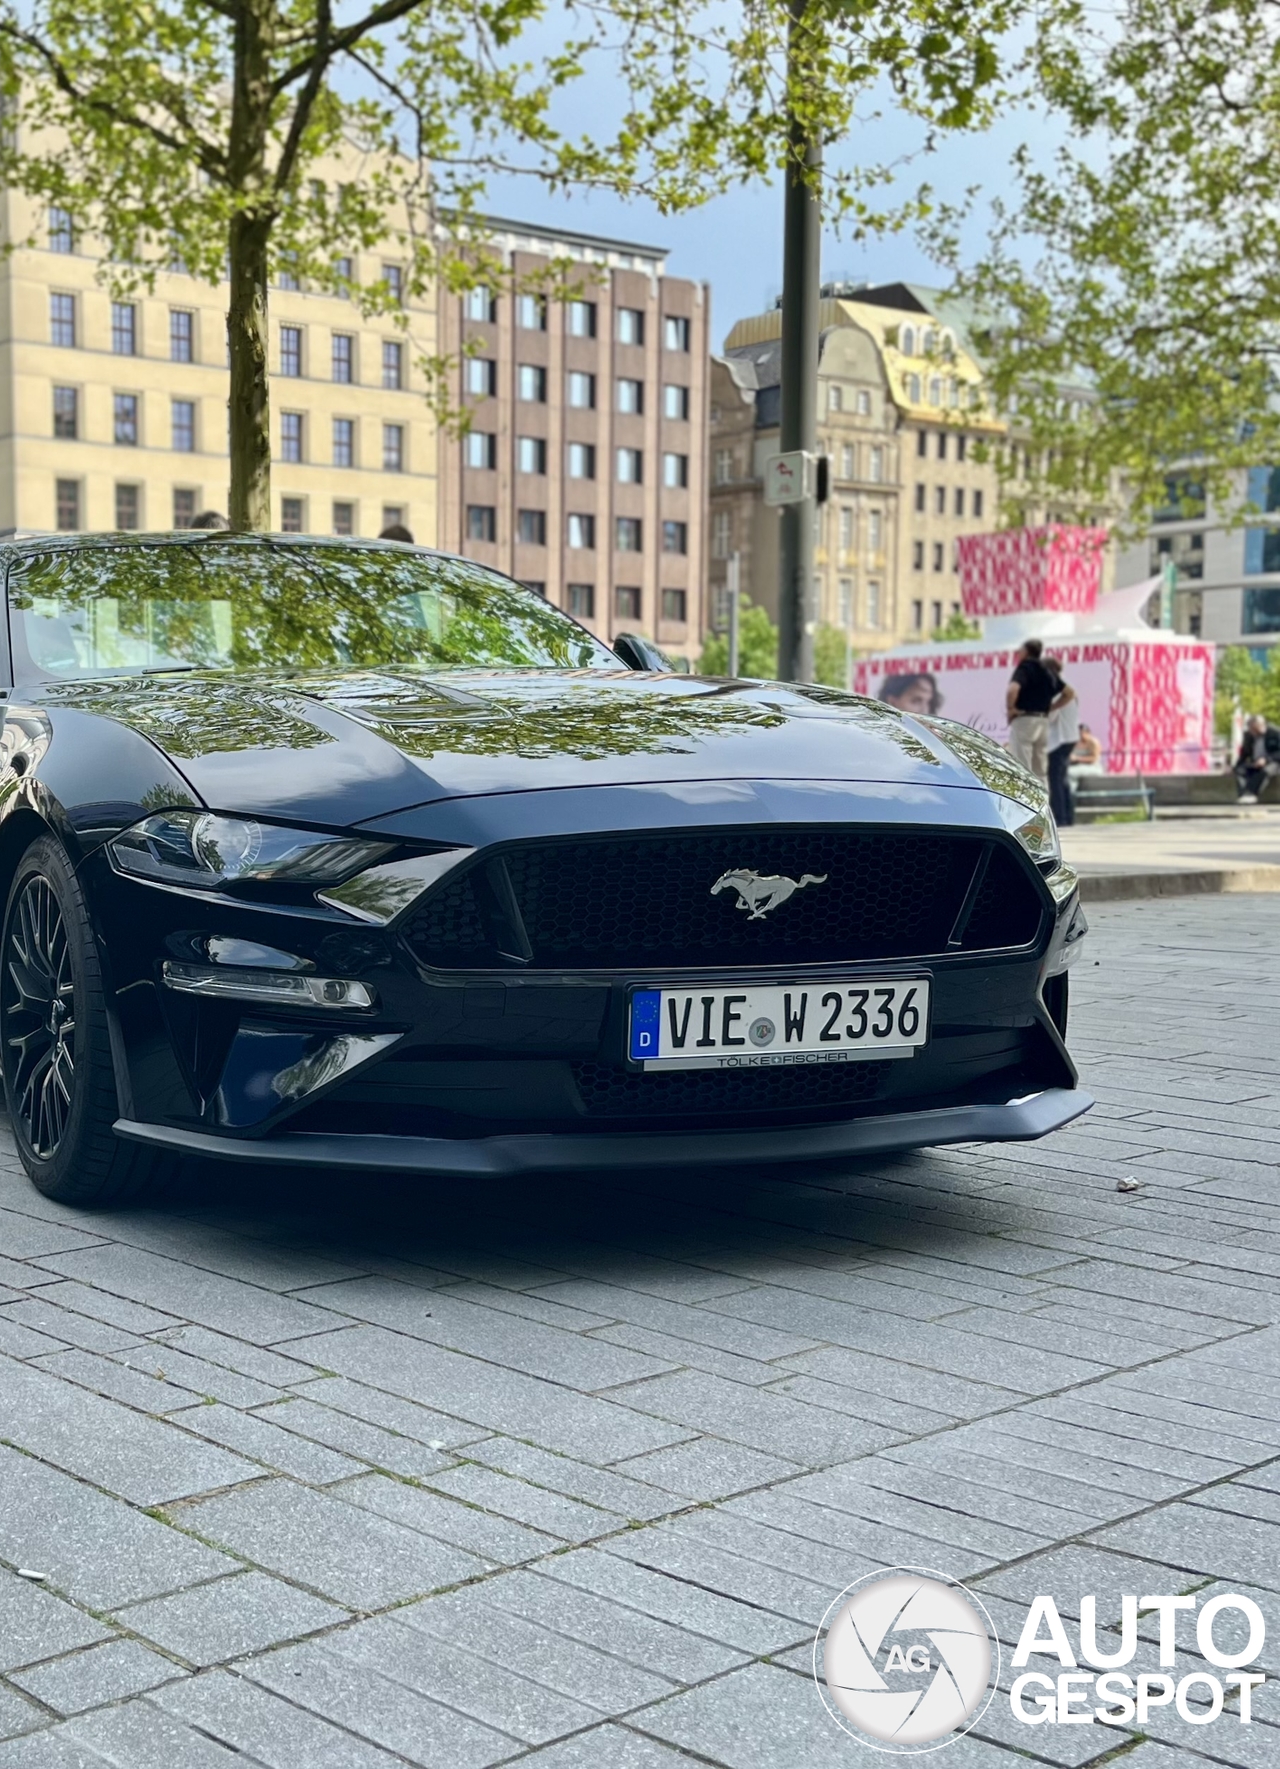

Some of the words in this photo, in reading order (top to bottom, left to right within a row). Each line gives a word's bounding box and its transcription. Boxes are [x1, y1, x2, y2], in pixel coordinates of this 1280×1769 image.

[667, 995, 747, 1049] VIE
[783, 992, 808, 1043] W
[819, 987, 919, 1042] 2336
[640, 1032, 651, 1047] D
[716, 1056, 771, 1067] TÖLKE
[782, 1052, 848, 1064] FISCHER
